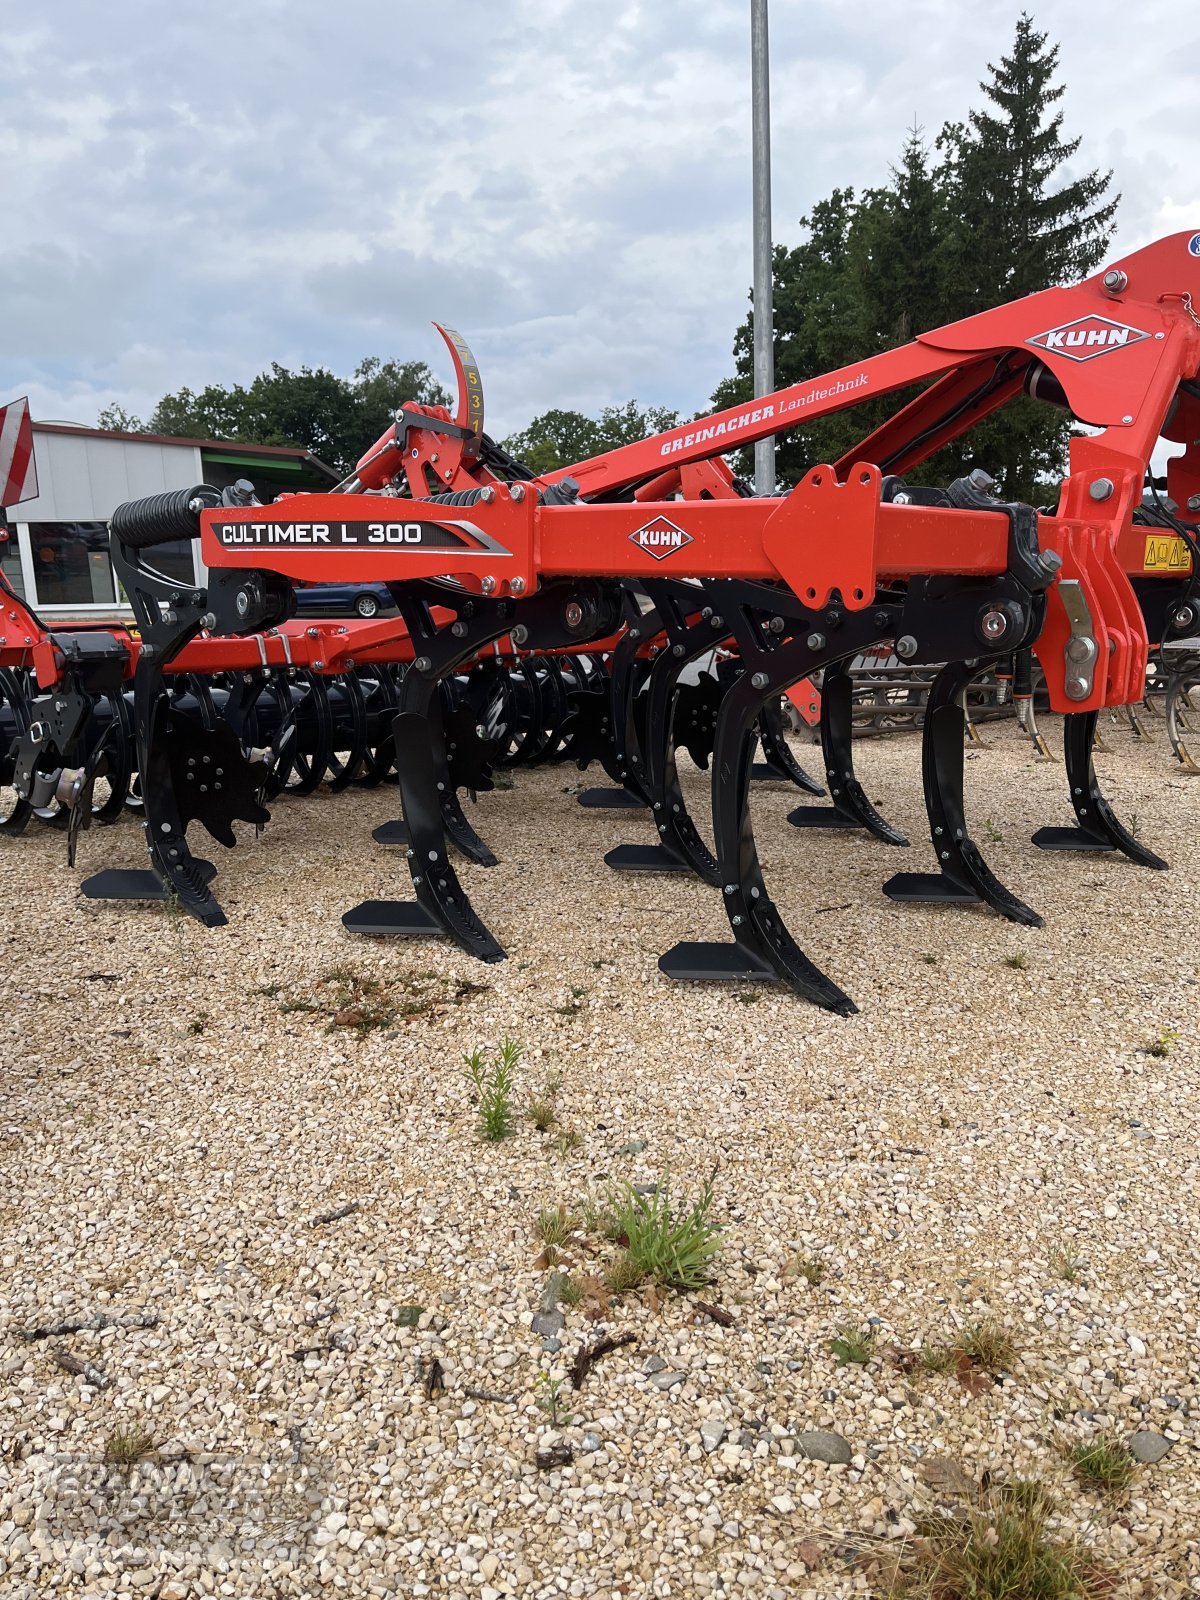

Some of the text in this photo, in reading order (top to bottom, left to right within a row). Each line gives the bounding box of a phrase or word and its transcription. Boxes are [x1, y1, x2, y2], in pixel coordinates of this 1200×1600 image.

[1045, 329, 1130, 348] KUHN
[468, 372, 478, 384] 5
[471, 395, 481, 408] 3
[660, 373, 869, 456] GREINACHER Landtechnik
[472, 419, 479, 432] 1
[222, 524, 422, 543] CULTIMER L 300
[639, 530, 682, 546] KUHN
